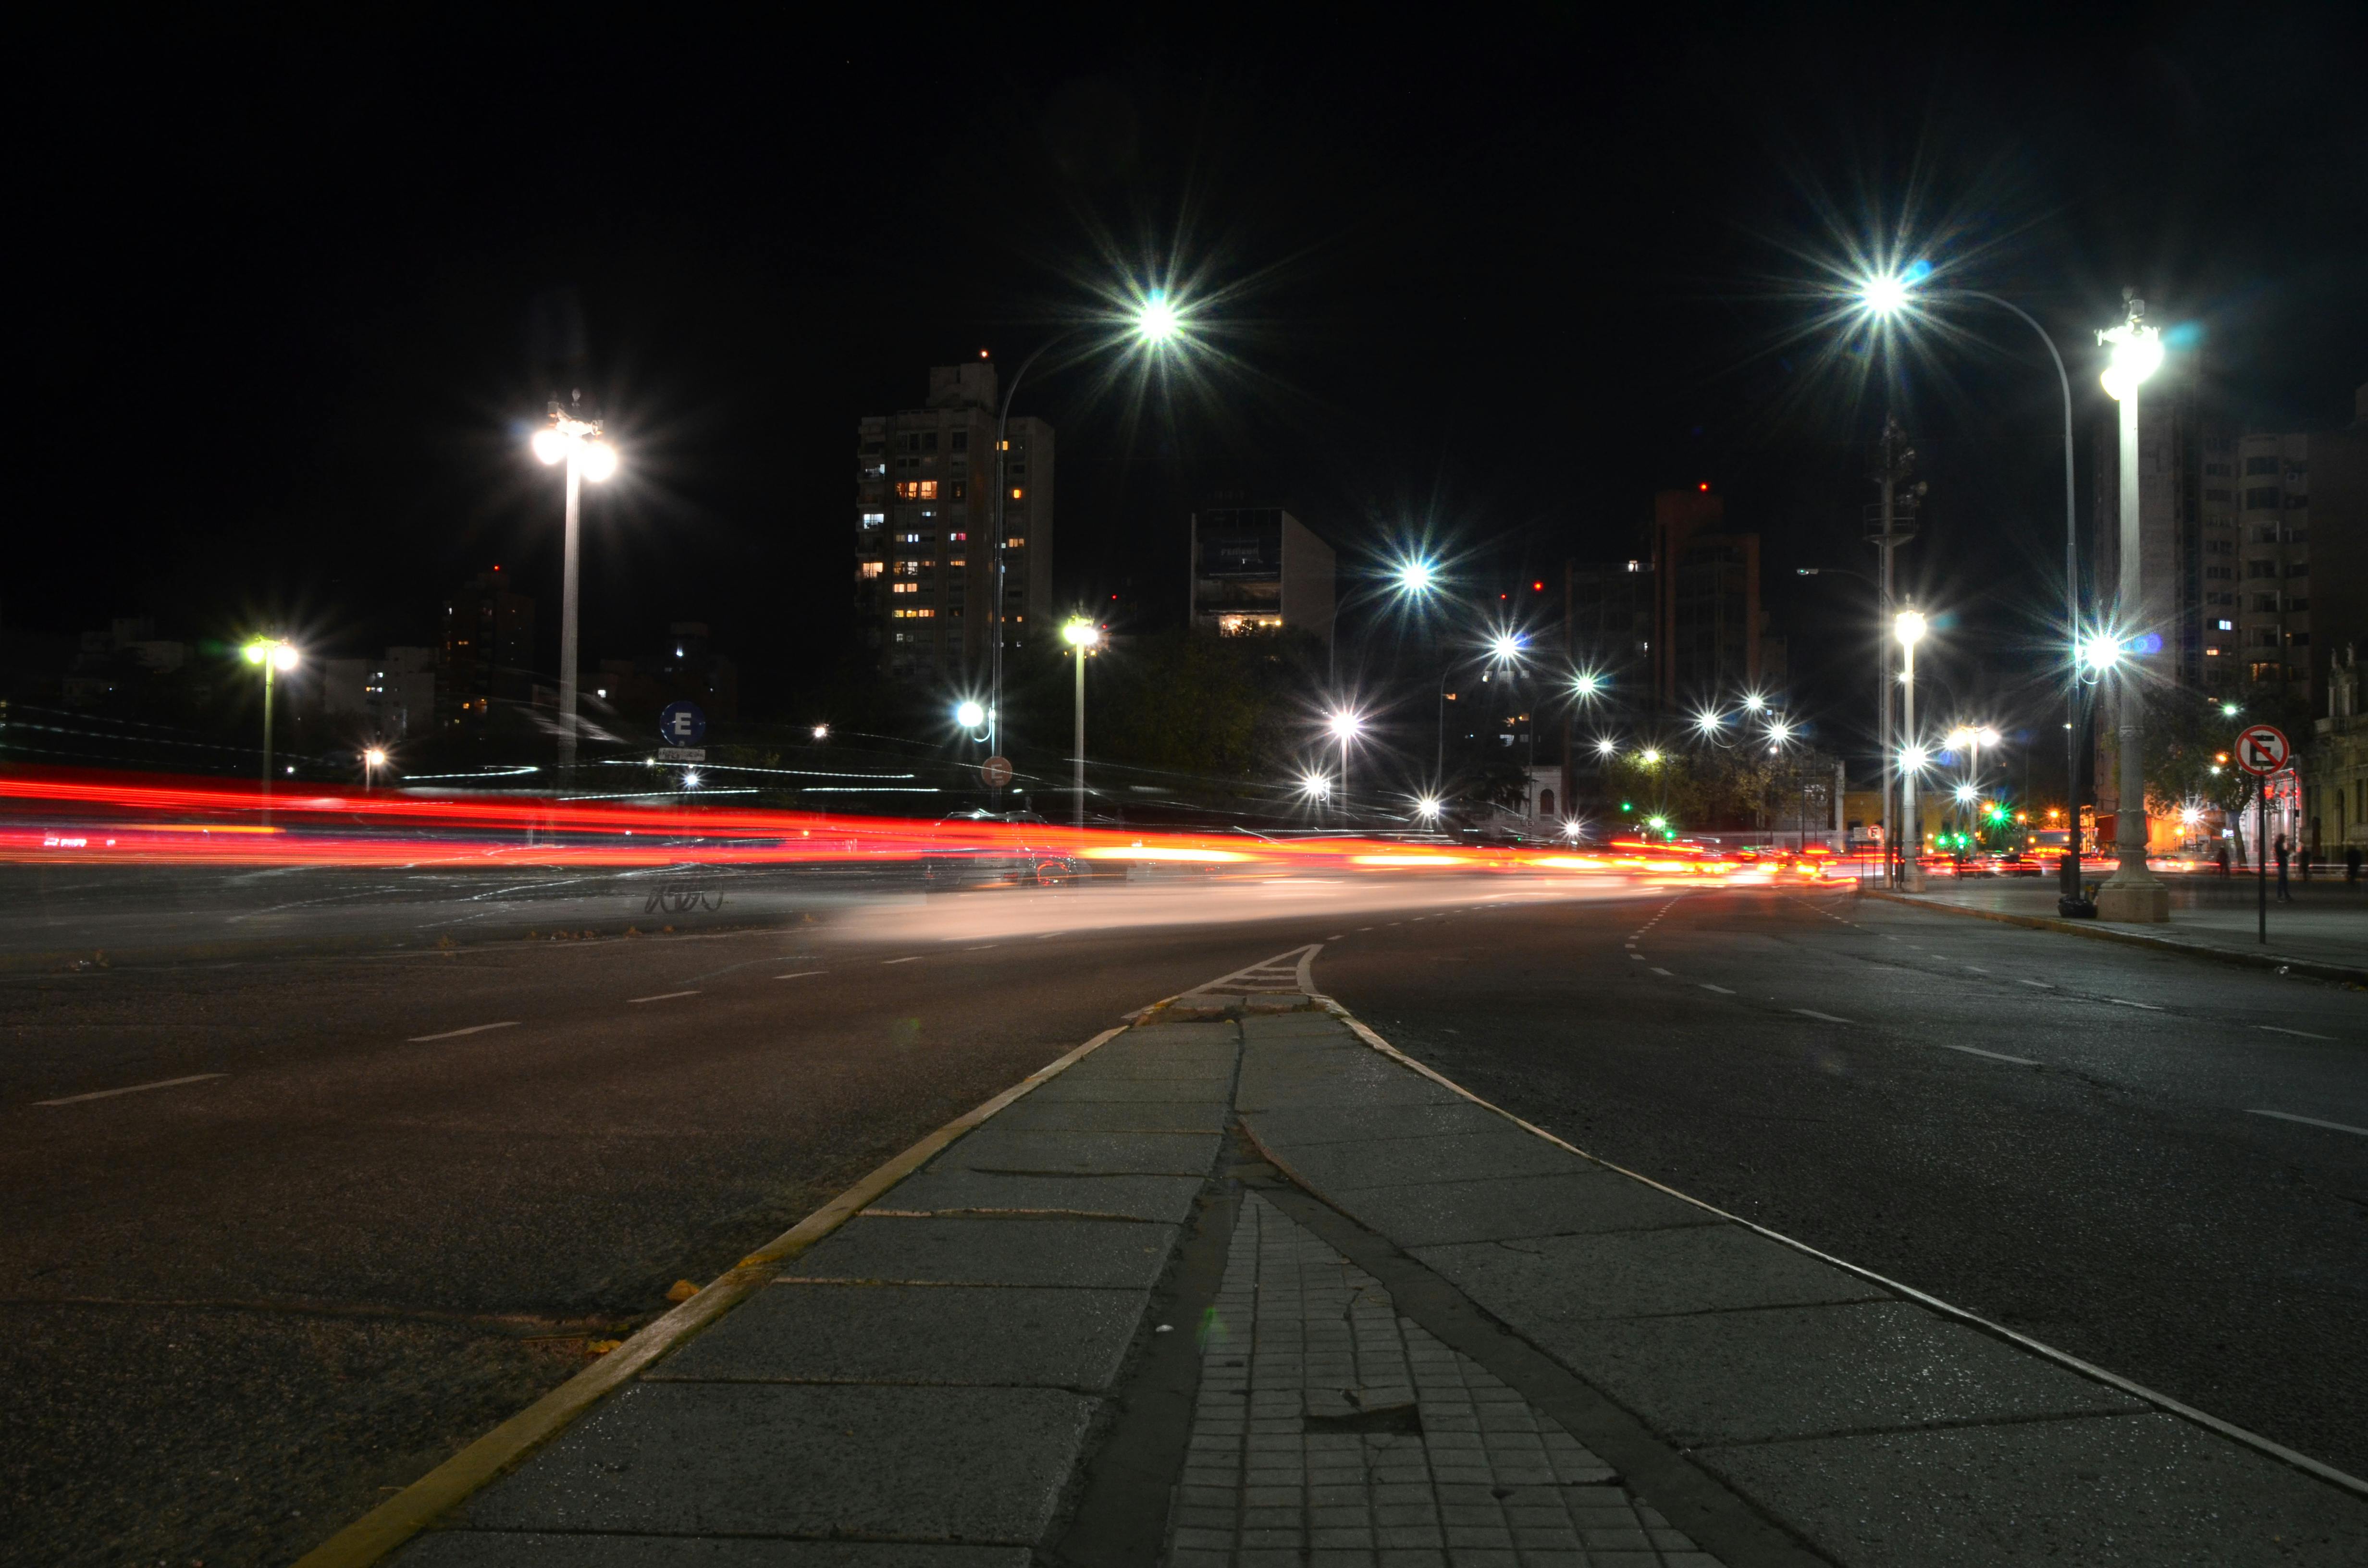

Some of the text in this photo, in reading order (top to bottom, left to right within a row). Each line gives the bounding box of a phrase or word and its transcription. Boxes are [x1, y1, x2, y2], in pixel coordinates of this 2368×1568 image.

[675, 712, 691, 735] E
[2250, 735, 2275, 766] E
[991, 764, 1002, 779] E
